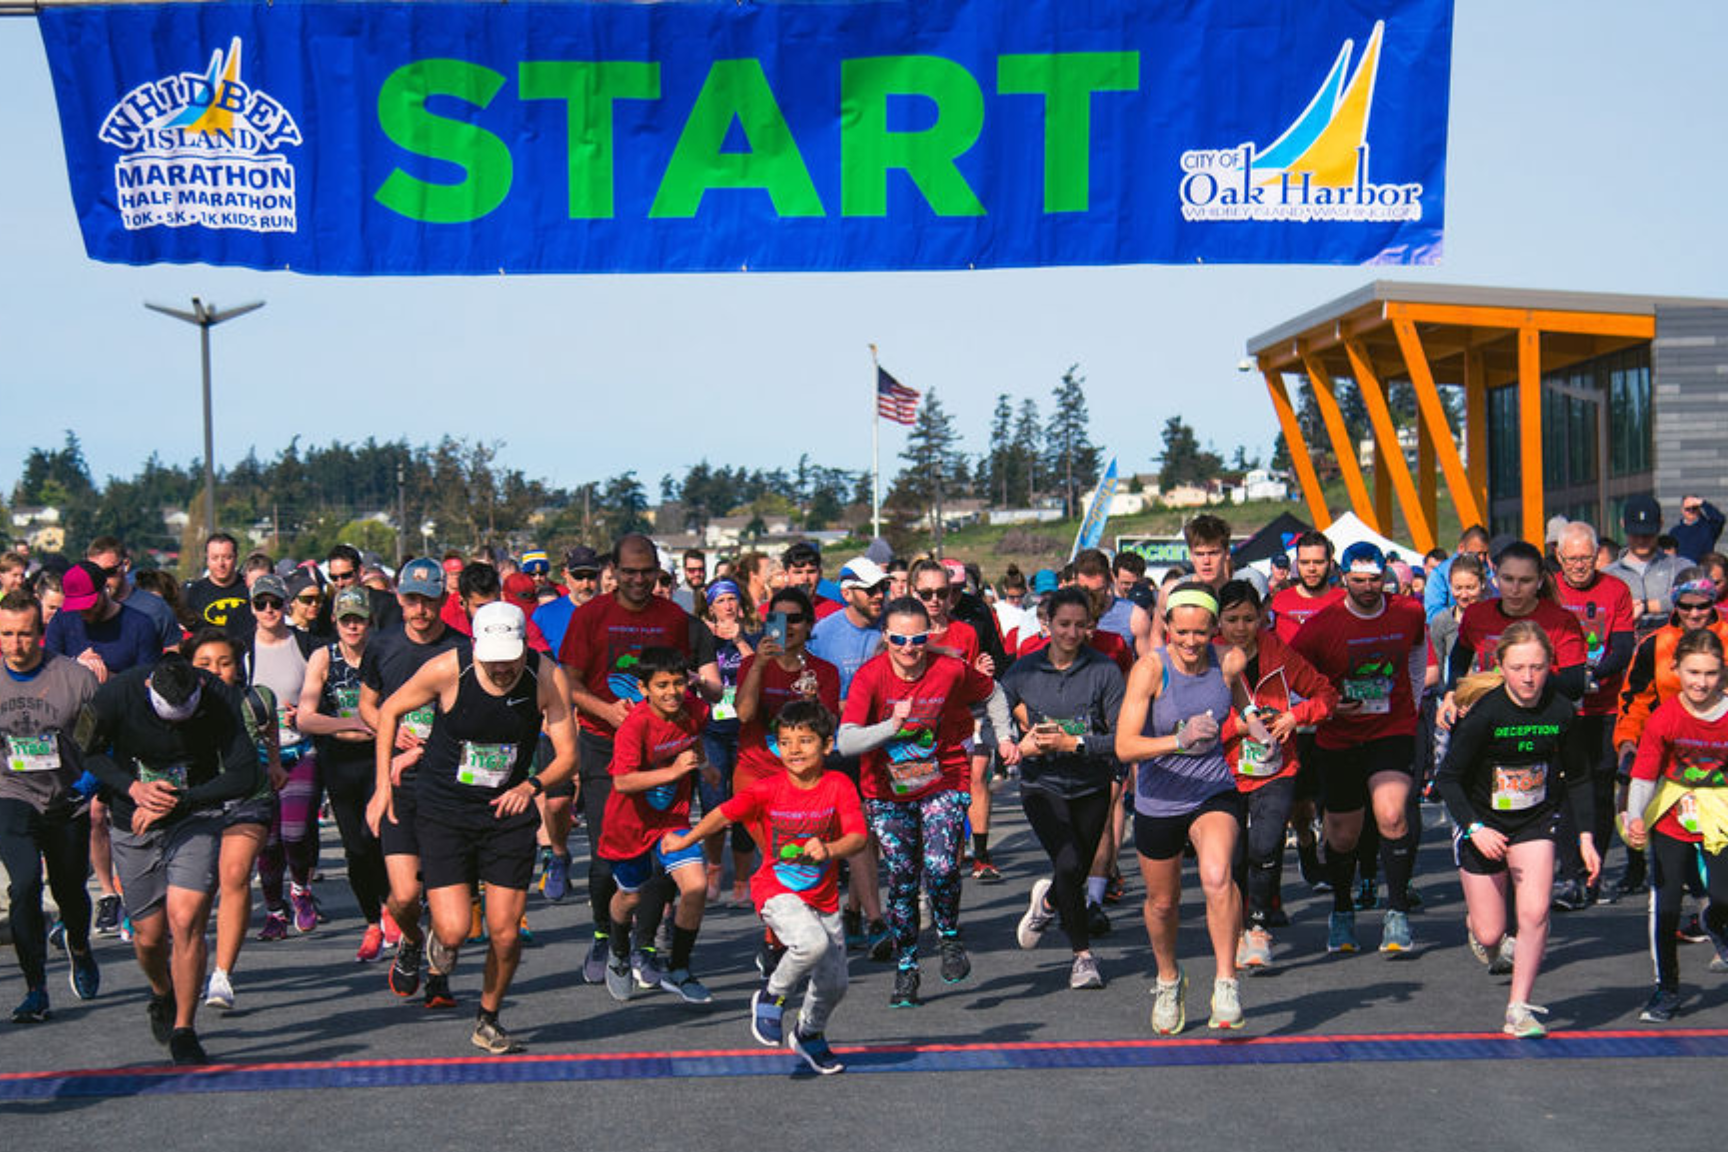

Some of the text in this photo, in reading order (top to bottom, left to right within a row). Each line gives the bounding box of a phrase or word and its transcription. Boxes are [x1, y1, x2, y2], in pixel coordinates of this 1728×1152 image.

[102, 76, 302, 149] WHIDBEY
[145, 127, 259, 151] ISLAND
[374, 51, 1140, 223] START
[1184, 153, 1239, 169] CITY OF
[118, 164, 293, 190] MARATHON
[1183, 145, 1420, 207] Oak Harbor
[121, 190, 293, 210] HALF MARATHON
[124, 211, 294, 229] 10K 5K 1K KIDS RUN
[1494, 725, 1561, 738] DECEPTION
[1517, 741, 1536, 753] FC
[470, 753, 509, 769] 1167
